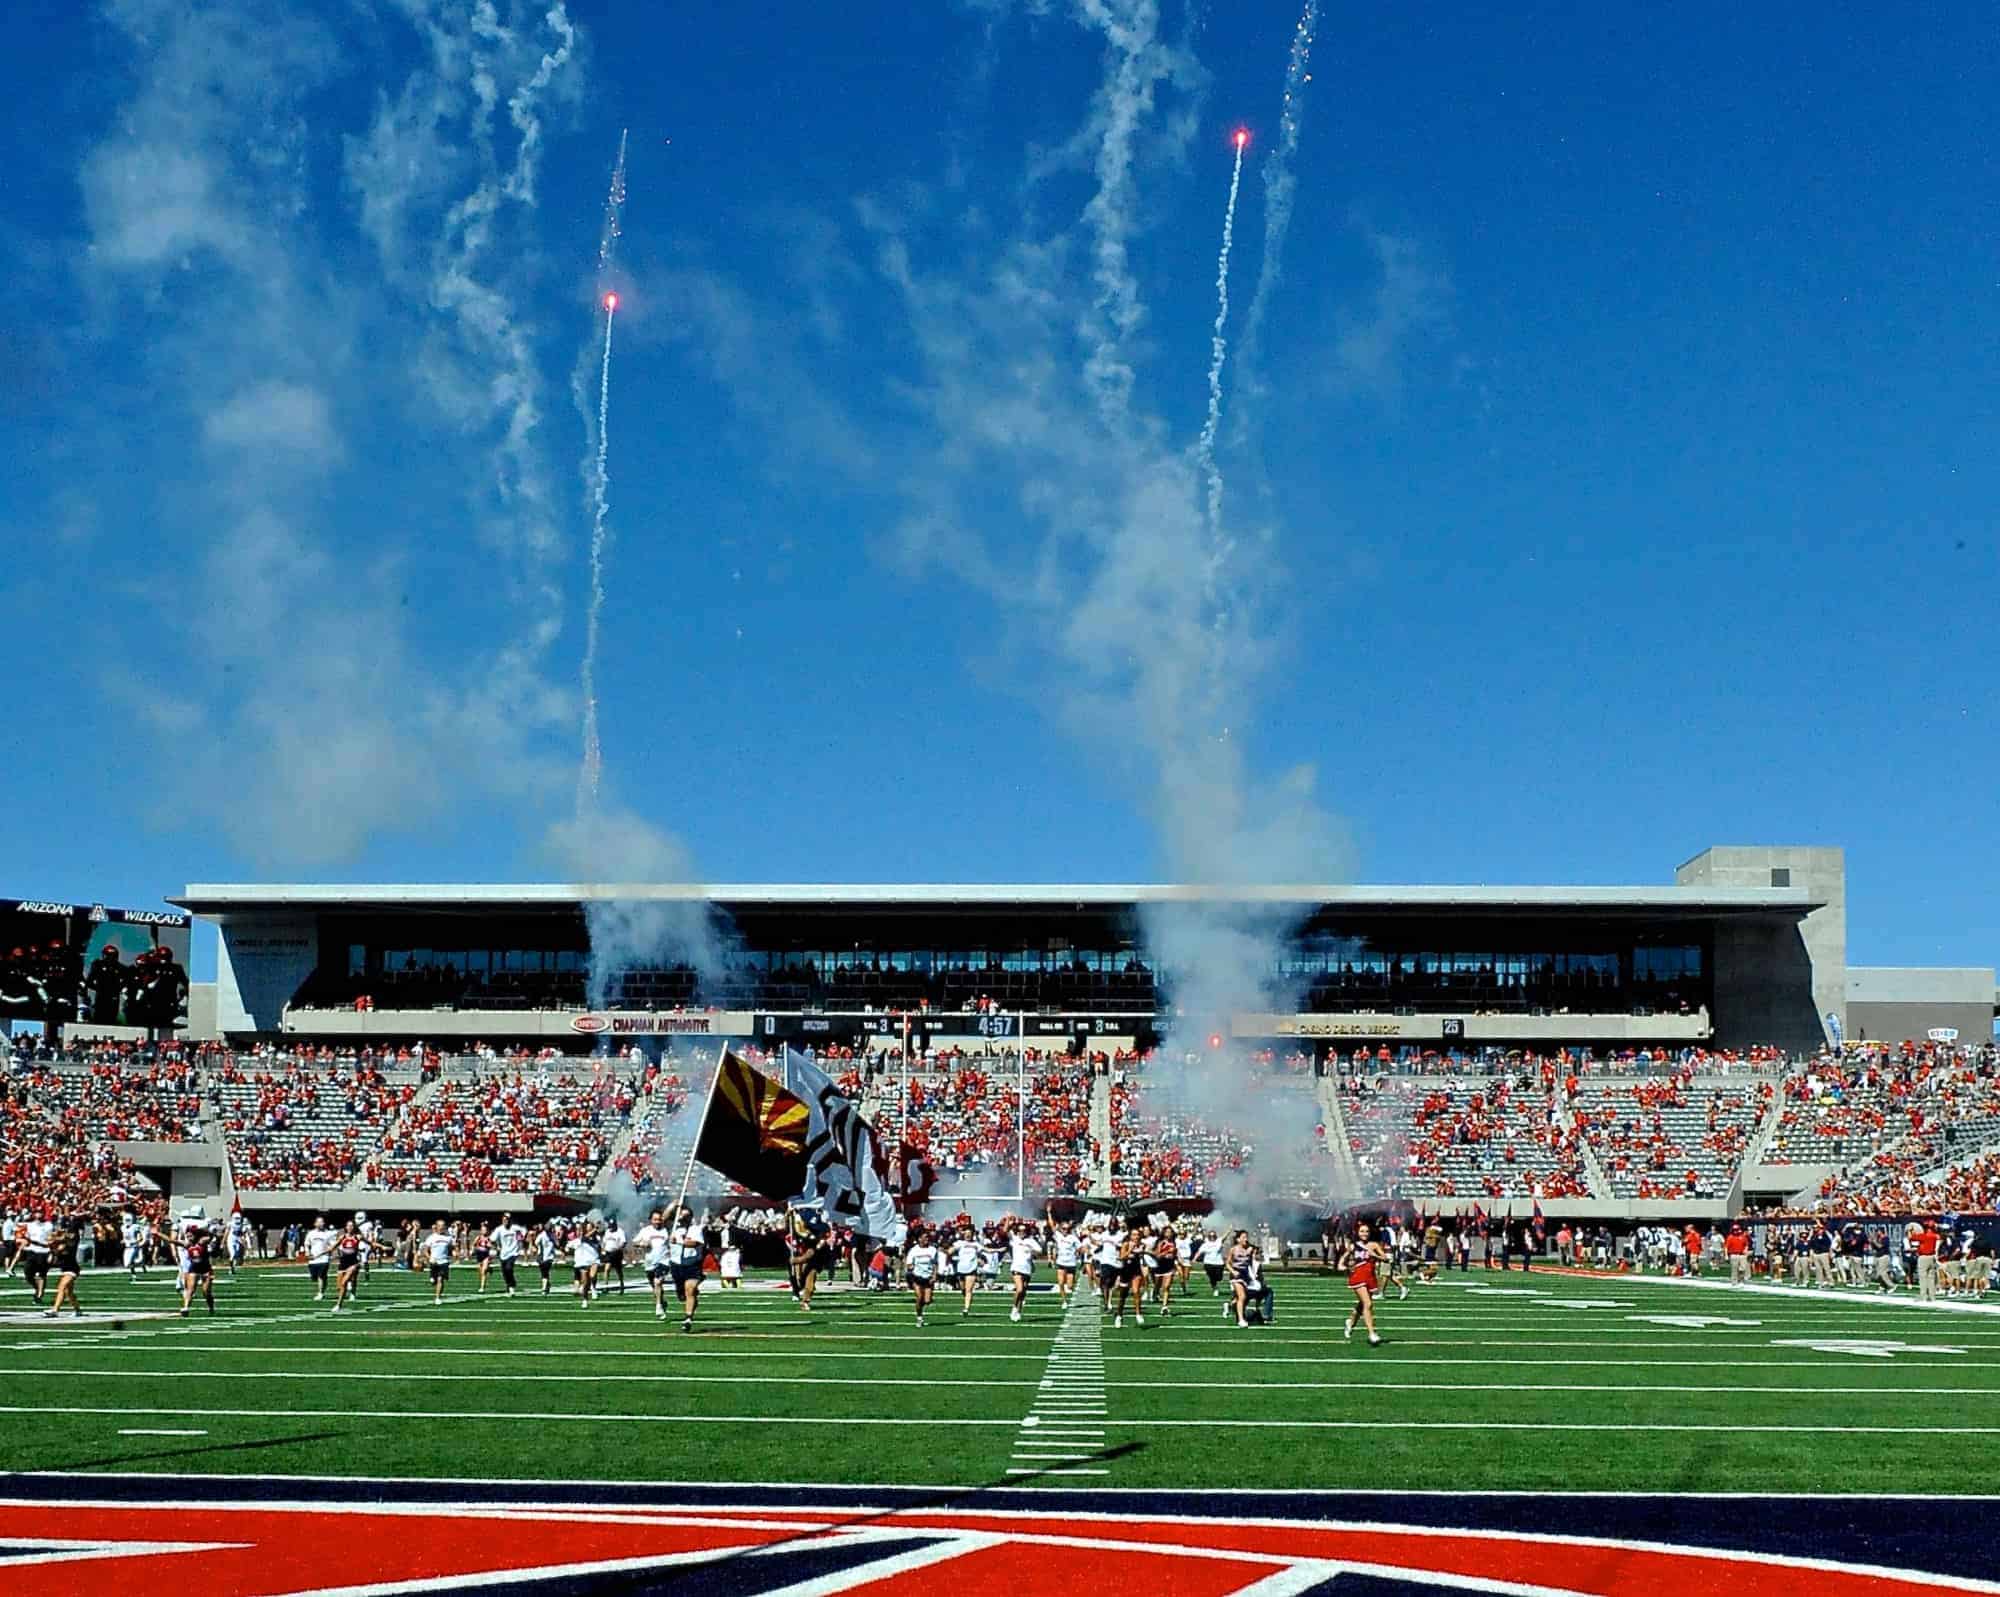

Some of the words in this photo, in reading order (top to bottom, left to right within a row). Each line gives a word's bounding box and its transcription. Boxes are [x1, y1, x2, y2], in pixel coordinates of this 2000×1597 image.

[16, 901, 73, 916] ARIZONA
[124, 910, 184, 925] WILDCATS
[613, 1018, 654, 1032] CHAPMAN
[658, 1018, 709, 1032] AUTOMOTIVE
[880, 1018, 888, 1032] 3
[978, 1016, 1012, 1035] 4:57
[1444, 1020, 1458, 1034] 25
